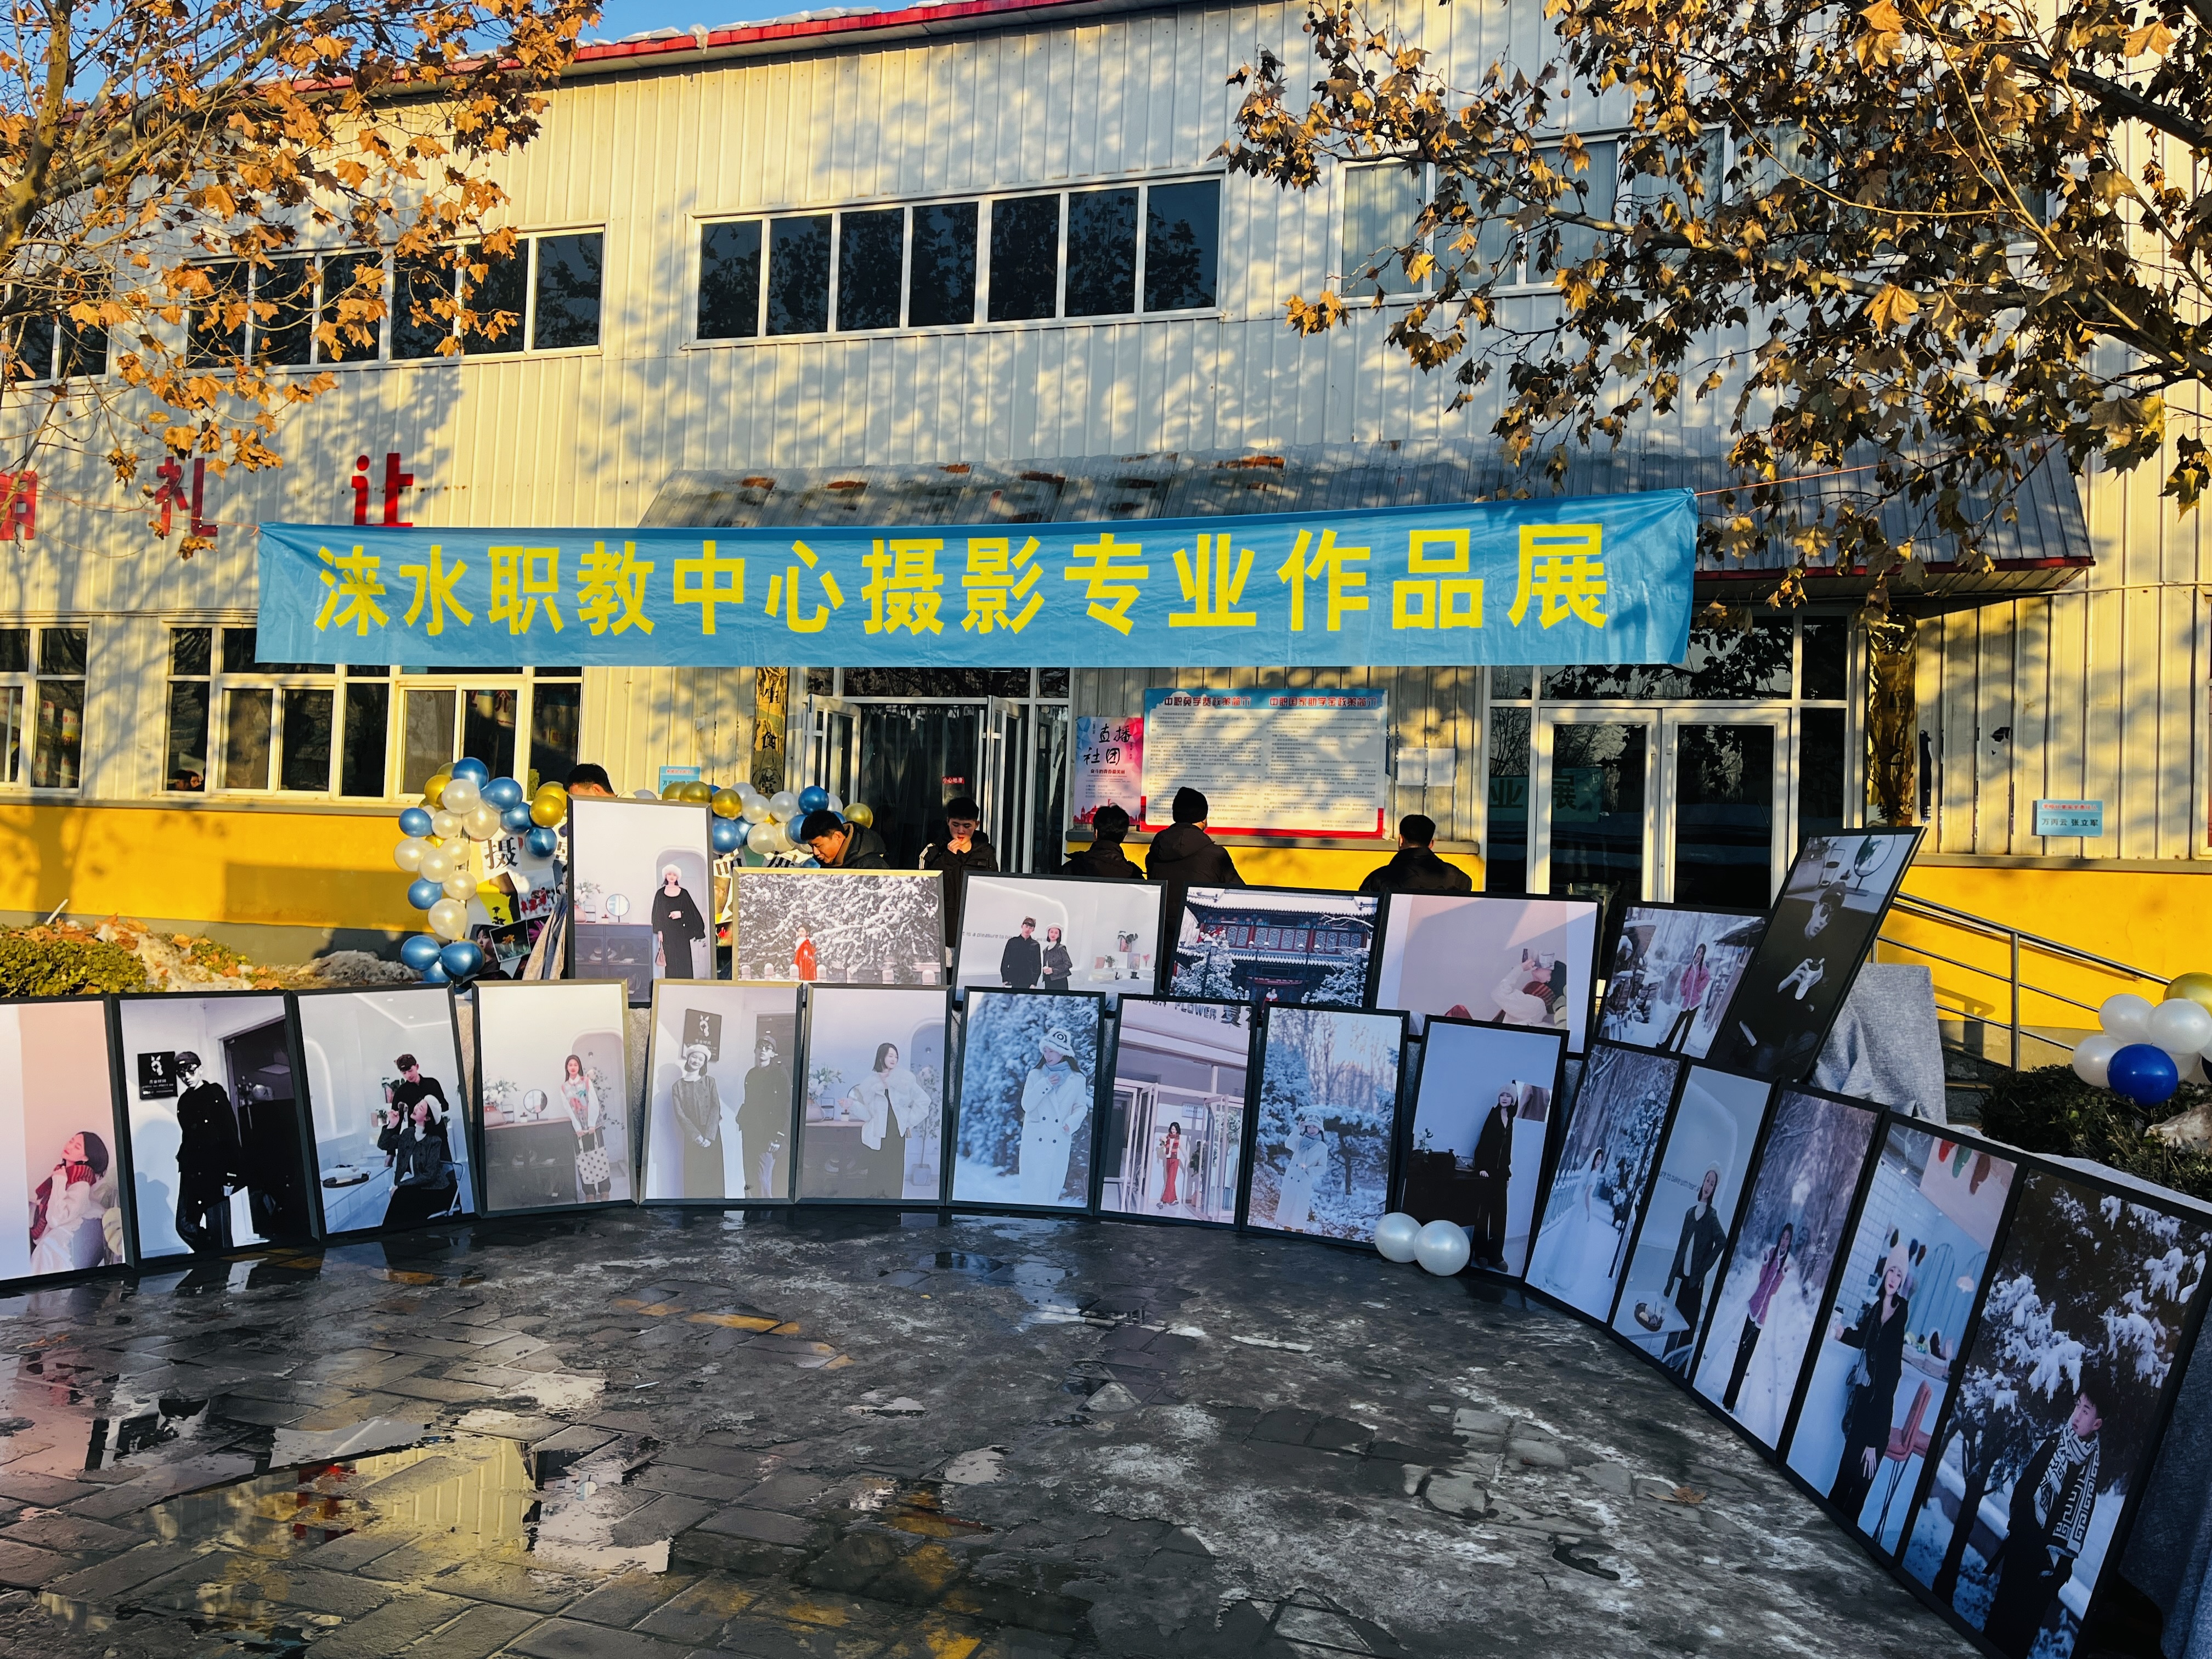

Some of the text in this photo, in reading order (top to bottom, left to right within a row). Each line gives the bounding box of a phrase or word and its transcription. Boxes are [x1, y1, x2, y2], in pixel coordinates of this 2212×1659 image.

[313, 522, 1609, 636] 涞水职教中心摄影专业作品展
[1164, 696, 1251, 707] 中职免学费政策简介
[1269, 697, 1378, 707] 中职国家助学金政策简介
[1098, 723, 1132, 743] 直播
[1083, 747, 1120, 766] 社团
[484, 836, 518, 870] 摄
[1175, 1002, 1217, 1022] FLOWER
